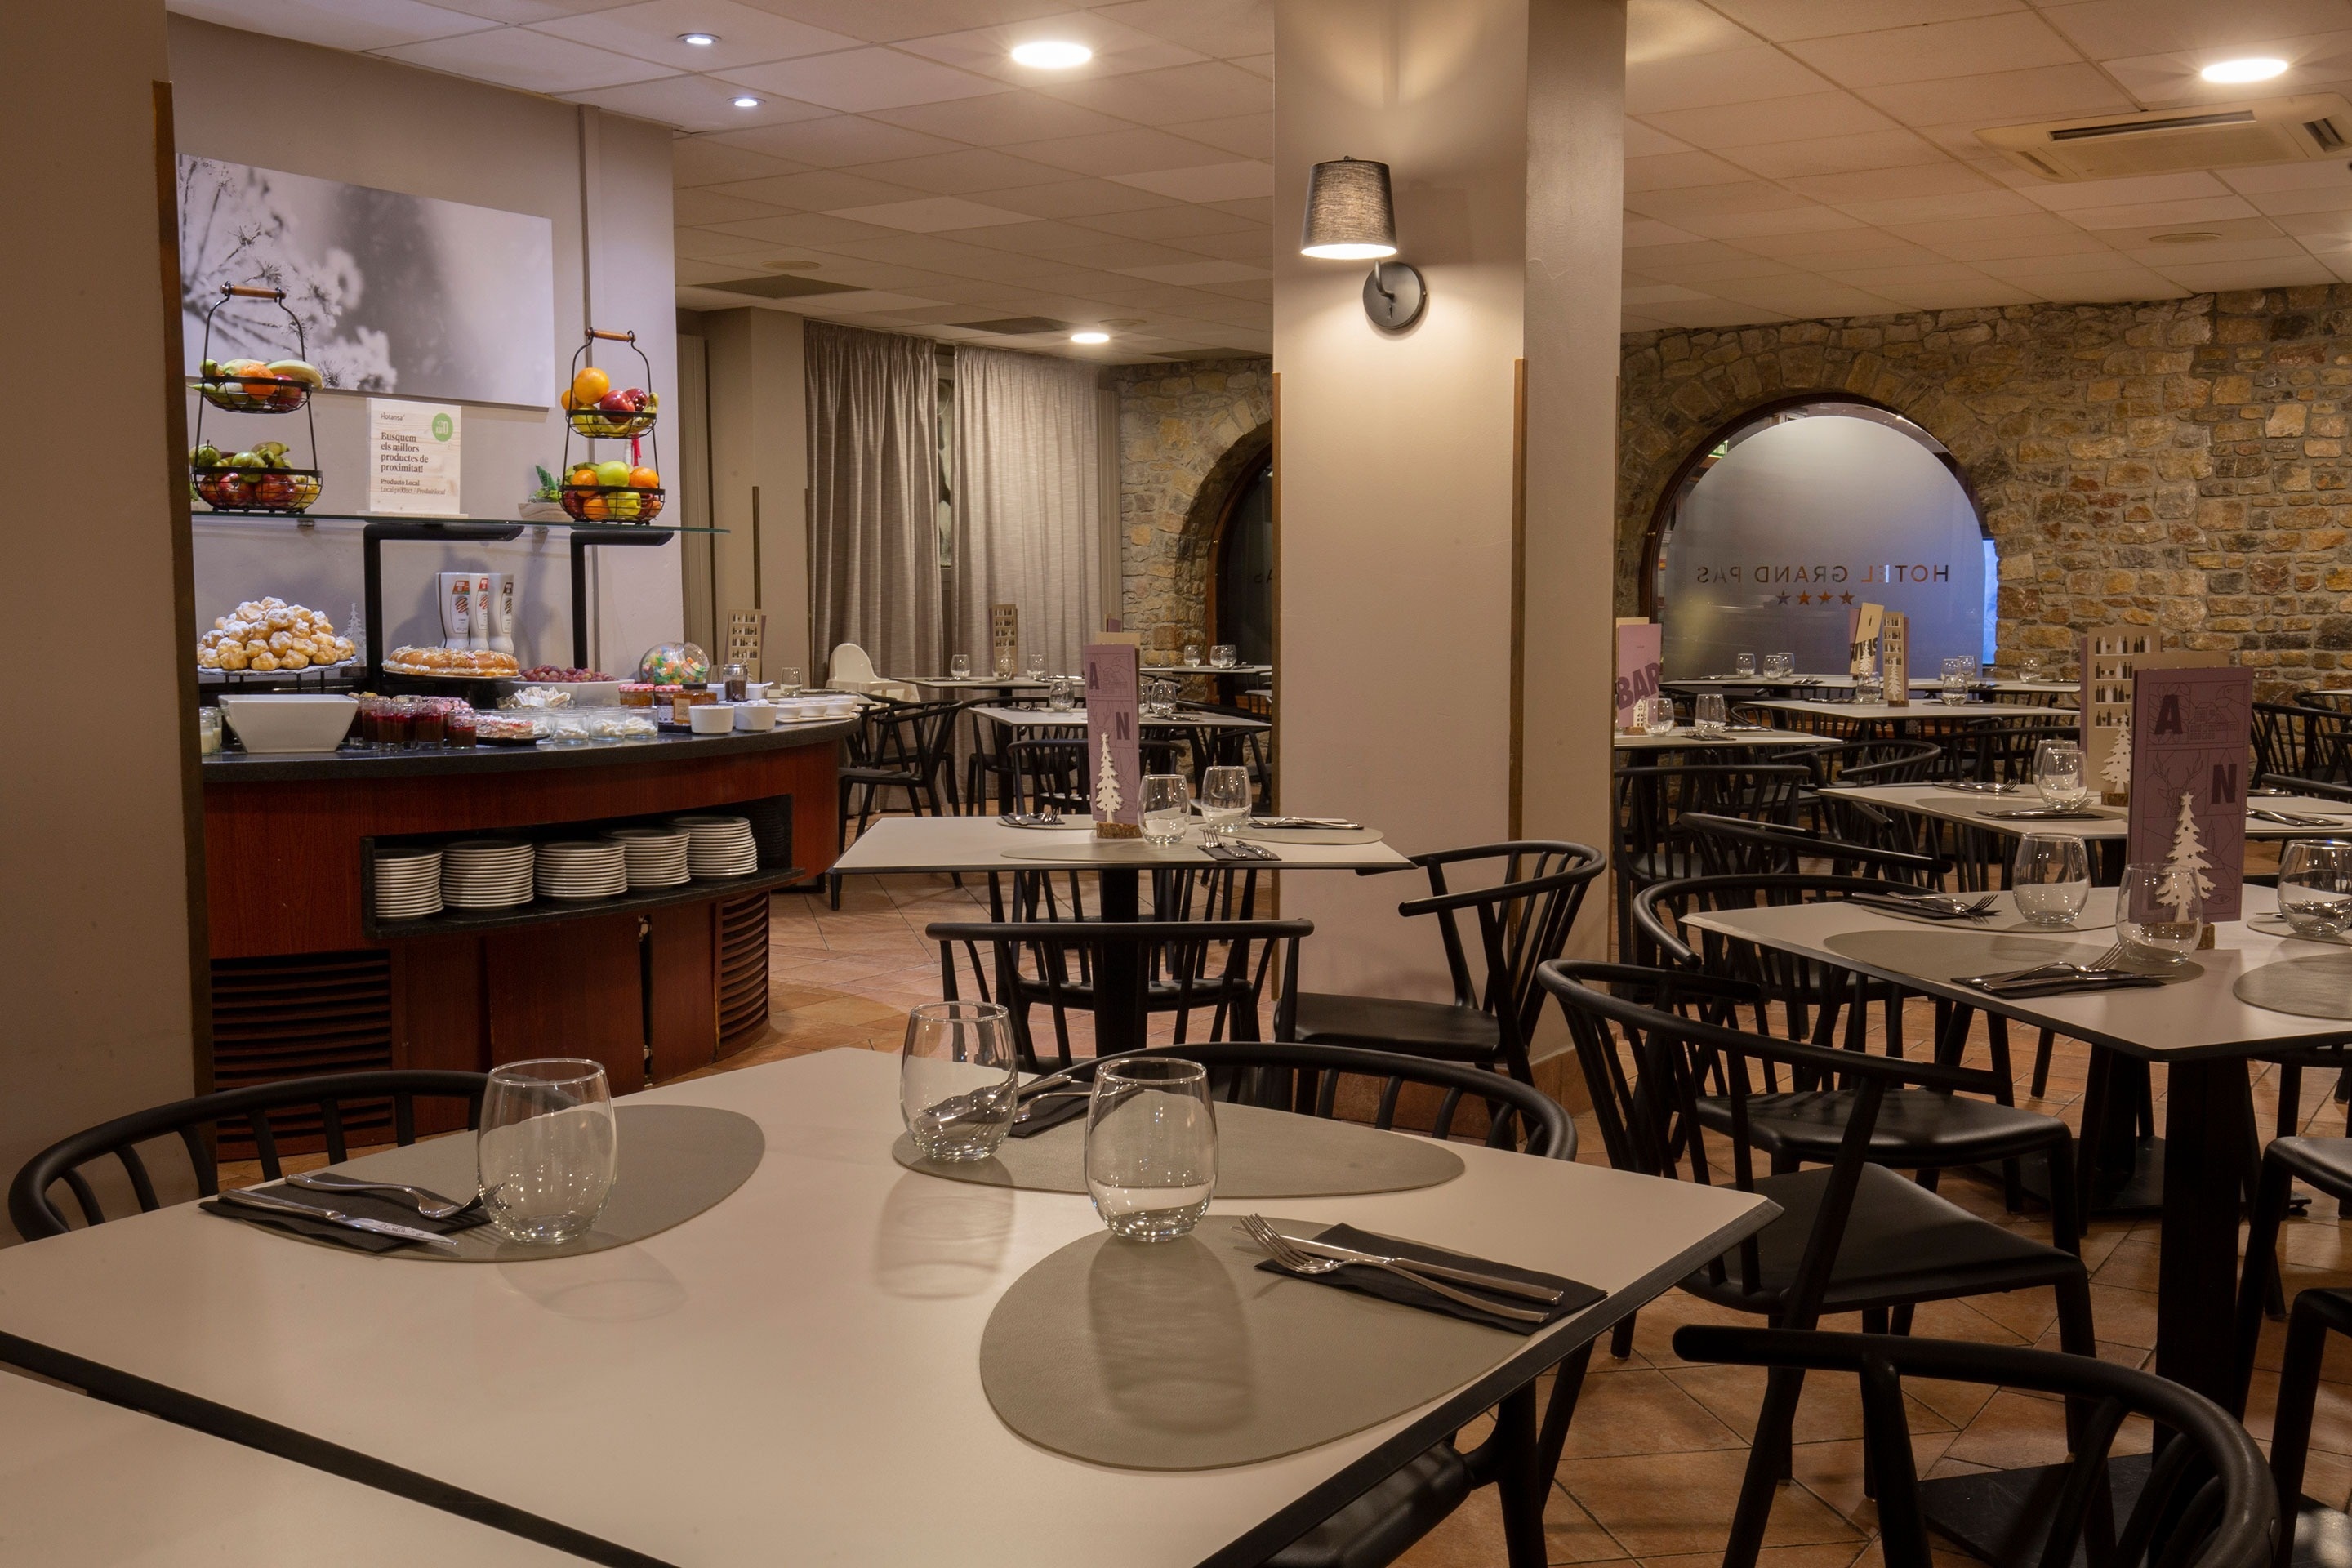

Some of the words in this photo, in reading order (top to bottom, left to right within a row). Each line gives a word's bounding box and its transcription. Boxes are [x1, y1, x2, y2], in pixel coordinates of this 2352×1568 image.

[381, 432, 416, 443] Busquem
[381, 442, 392, 451] els
[392, 443, 420, 452] millors
[381, 453, 419, 463] productes
[419, 455, 429, 464] de
[381, 464, 424, 474] proximitat!
[1089, 662, 1100, 691] A
[1617, 662, 1660, 710] BAR
[1115, 711, 1130, 741] N
[2154, 694, 2184, 736] A
[2211, 764, 2238, 804] N
